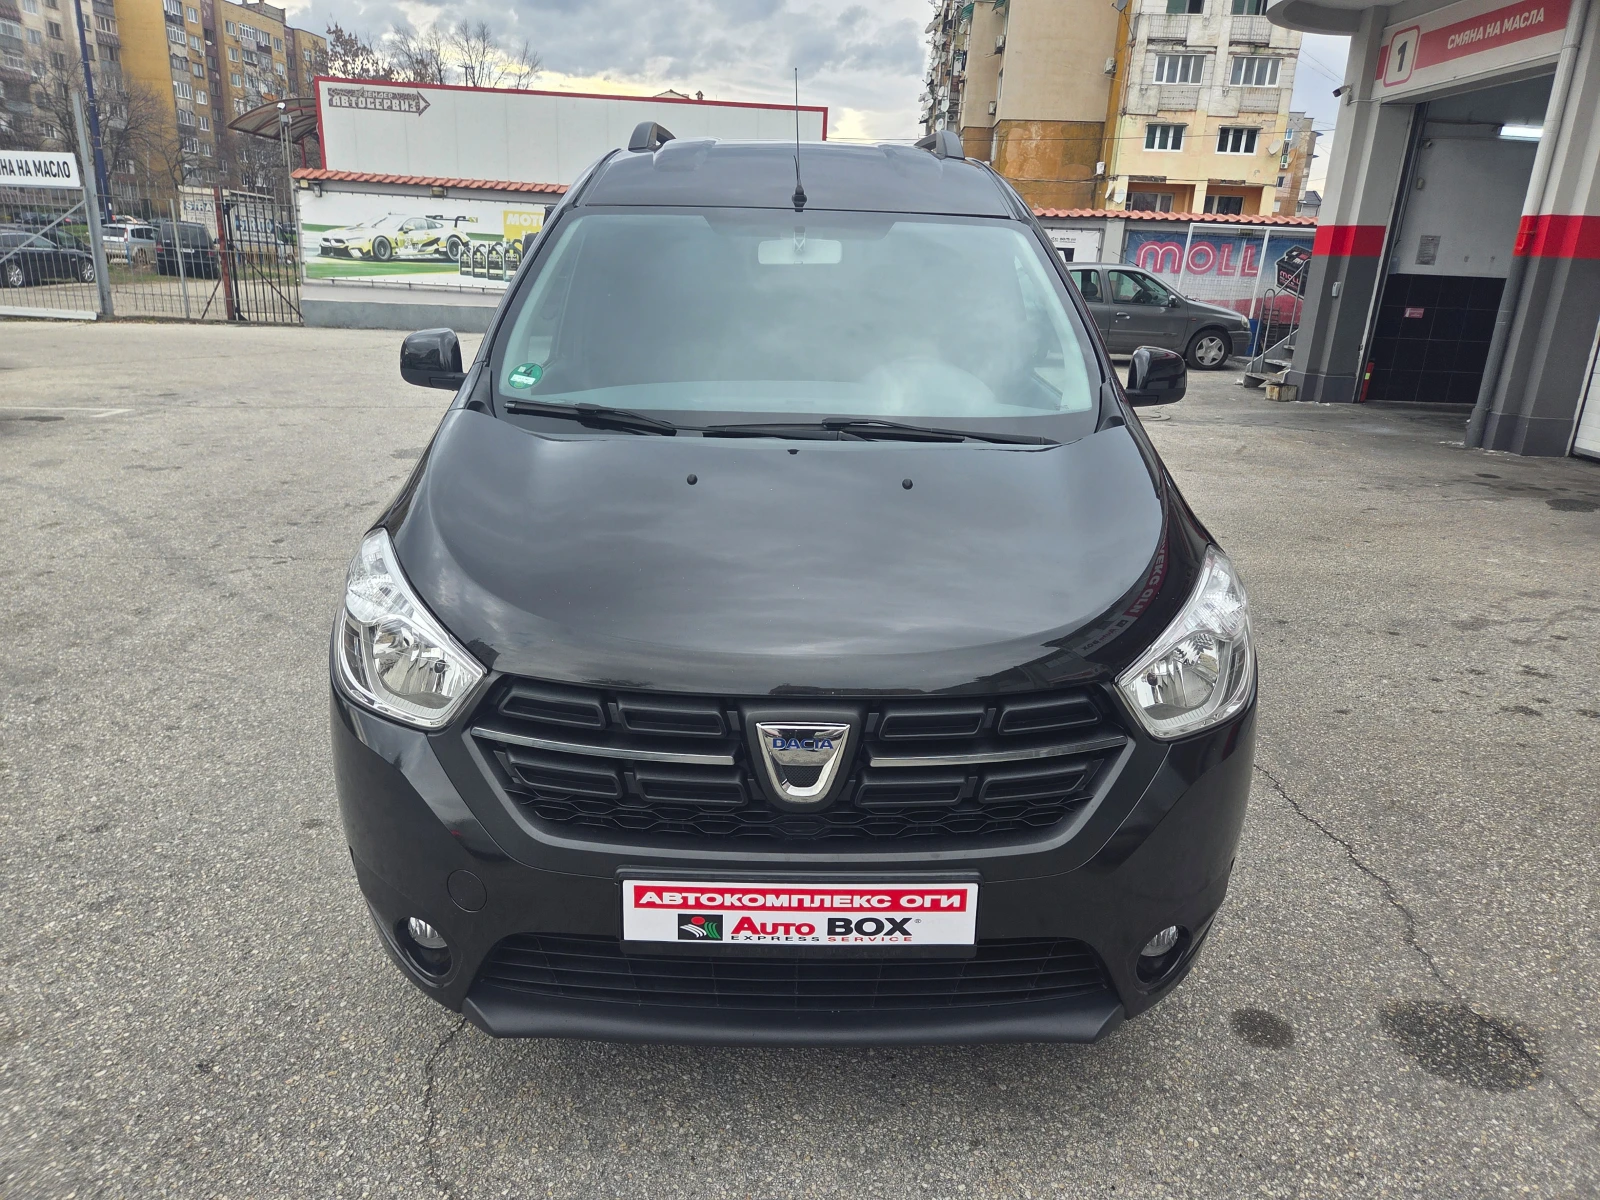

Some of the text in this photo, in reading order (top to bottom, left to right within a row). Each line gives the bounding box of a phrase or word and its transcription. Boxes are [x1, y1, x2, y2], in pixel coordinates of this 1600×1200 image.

[1447, 7, 1545, 50] СМЯНА НА МАСЛА
[1397, 41, 1408, 72] 1
[332, 95, 418, 112] АВТОСЕРВИЗ
[0, 158, 71, 179] НА НА МАСЛО
[1135, 240, 1259, 277] MOLL
[523, 364, 536, 377] 4
[772, 738, 834, 750] DACIA
[638, 891, 961, 908] АВТОКОМПЛЕКС ОГИ
